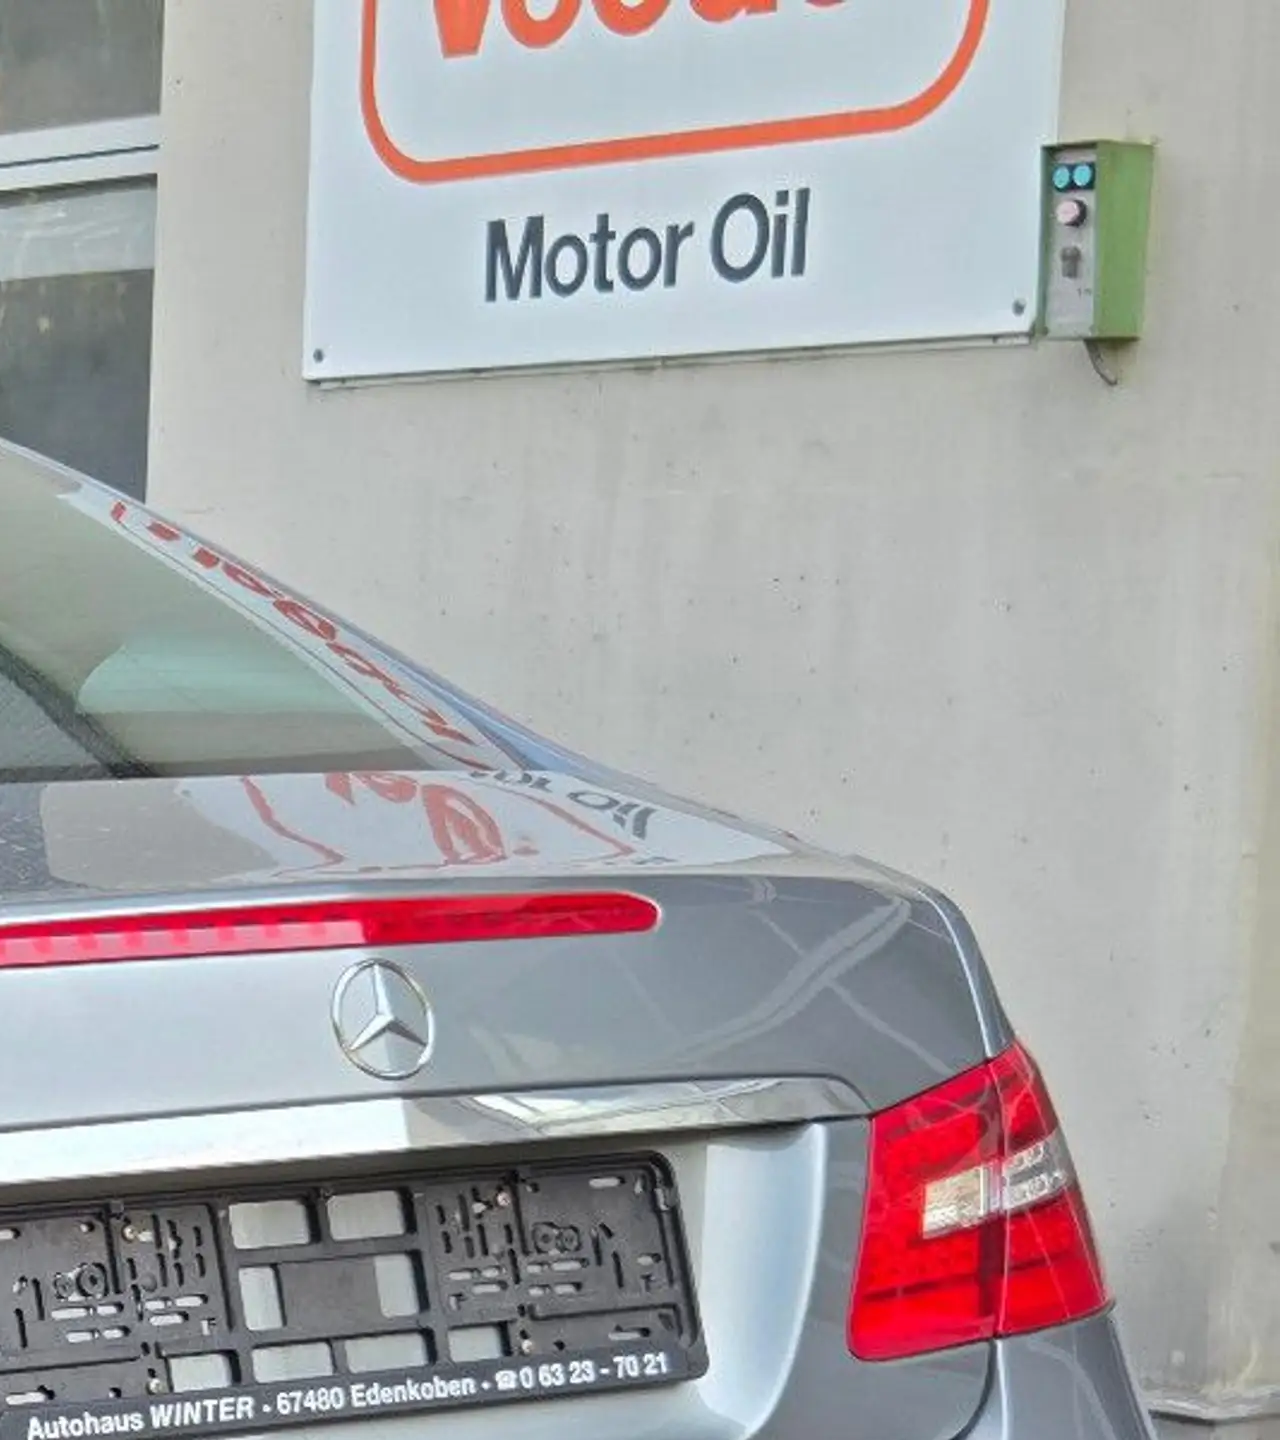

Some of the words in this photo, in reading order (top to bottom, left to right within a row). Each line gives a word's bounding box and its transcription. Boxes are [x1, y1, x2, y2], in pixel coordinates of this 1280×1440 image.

[484, 213, 696, 303] Motor
[709, 187, 811, 284] Oil
[27, 1411, 145, 1440] Autohaus
[150, 1396, 255, 1428] WINTER
[276, 1386, 345, 1415] 67480
[349, 1376, 477, 1408] Edenkoben
[518, 1366, 535, 1390] 0
[539, 1365, 566, 1388] 63
[569, 1360, 596, 1384] 23
[613, 1355, 639, 1379] 70
[643, 1350, 669, 1376] 21
